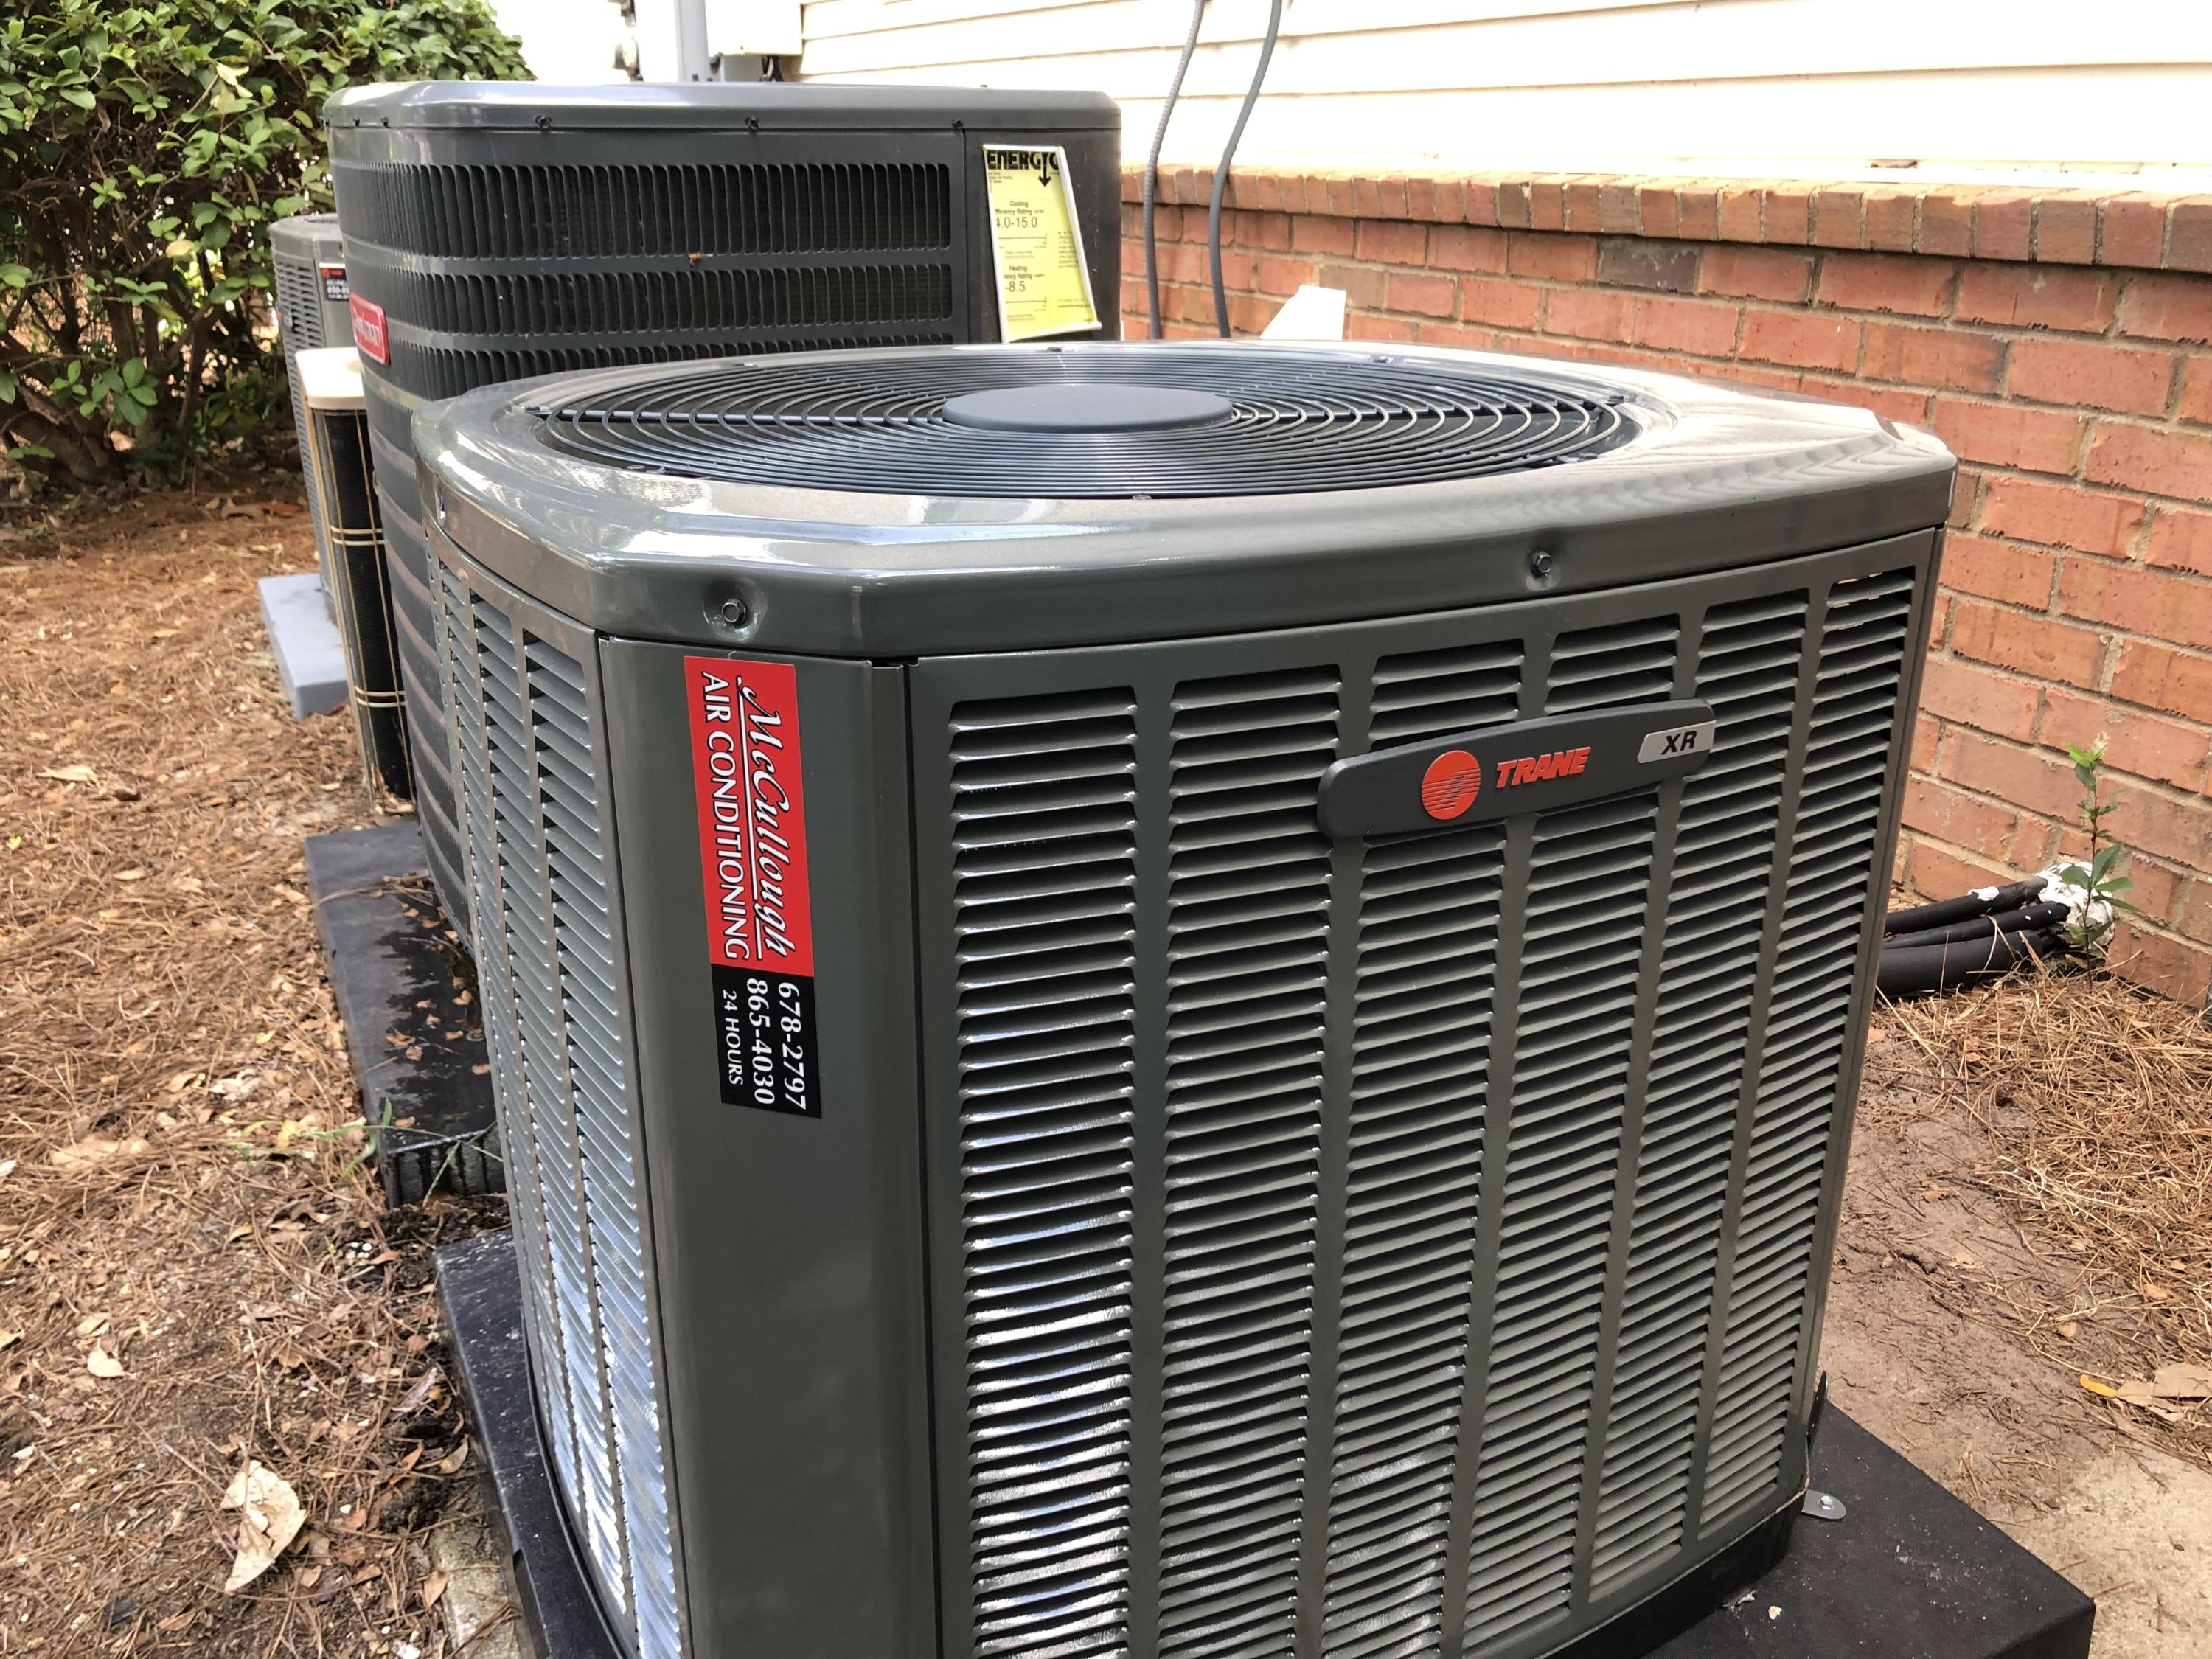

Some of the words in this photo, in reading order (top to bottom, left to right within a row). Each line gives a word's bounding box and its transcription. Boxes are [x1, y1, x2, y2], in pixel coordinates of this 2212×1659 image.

[701, 672, 732, 723] AIR
[1495, 746, 1591, 788] TRANE
[1660, 730, 1698, 756] XR
[706, 730, 751, 960] CONDITIONING
[741, 686, 796, 958] McCullough
[723, 989, 738, 1012] 24
[746, 978, 775, 1105] 865-4030
[778, 981, 807, 1110] 678-2797
[725, 1018, 744, 1085] HOURS
